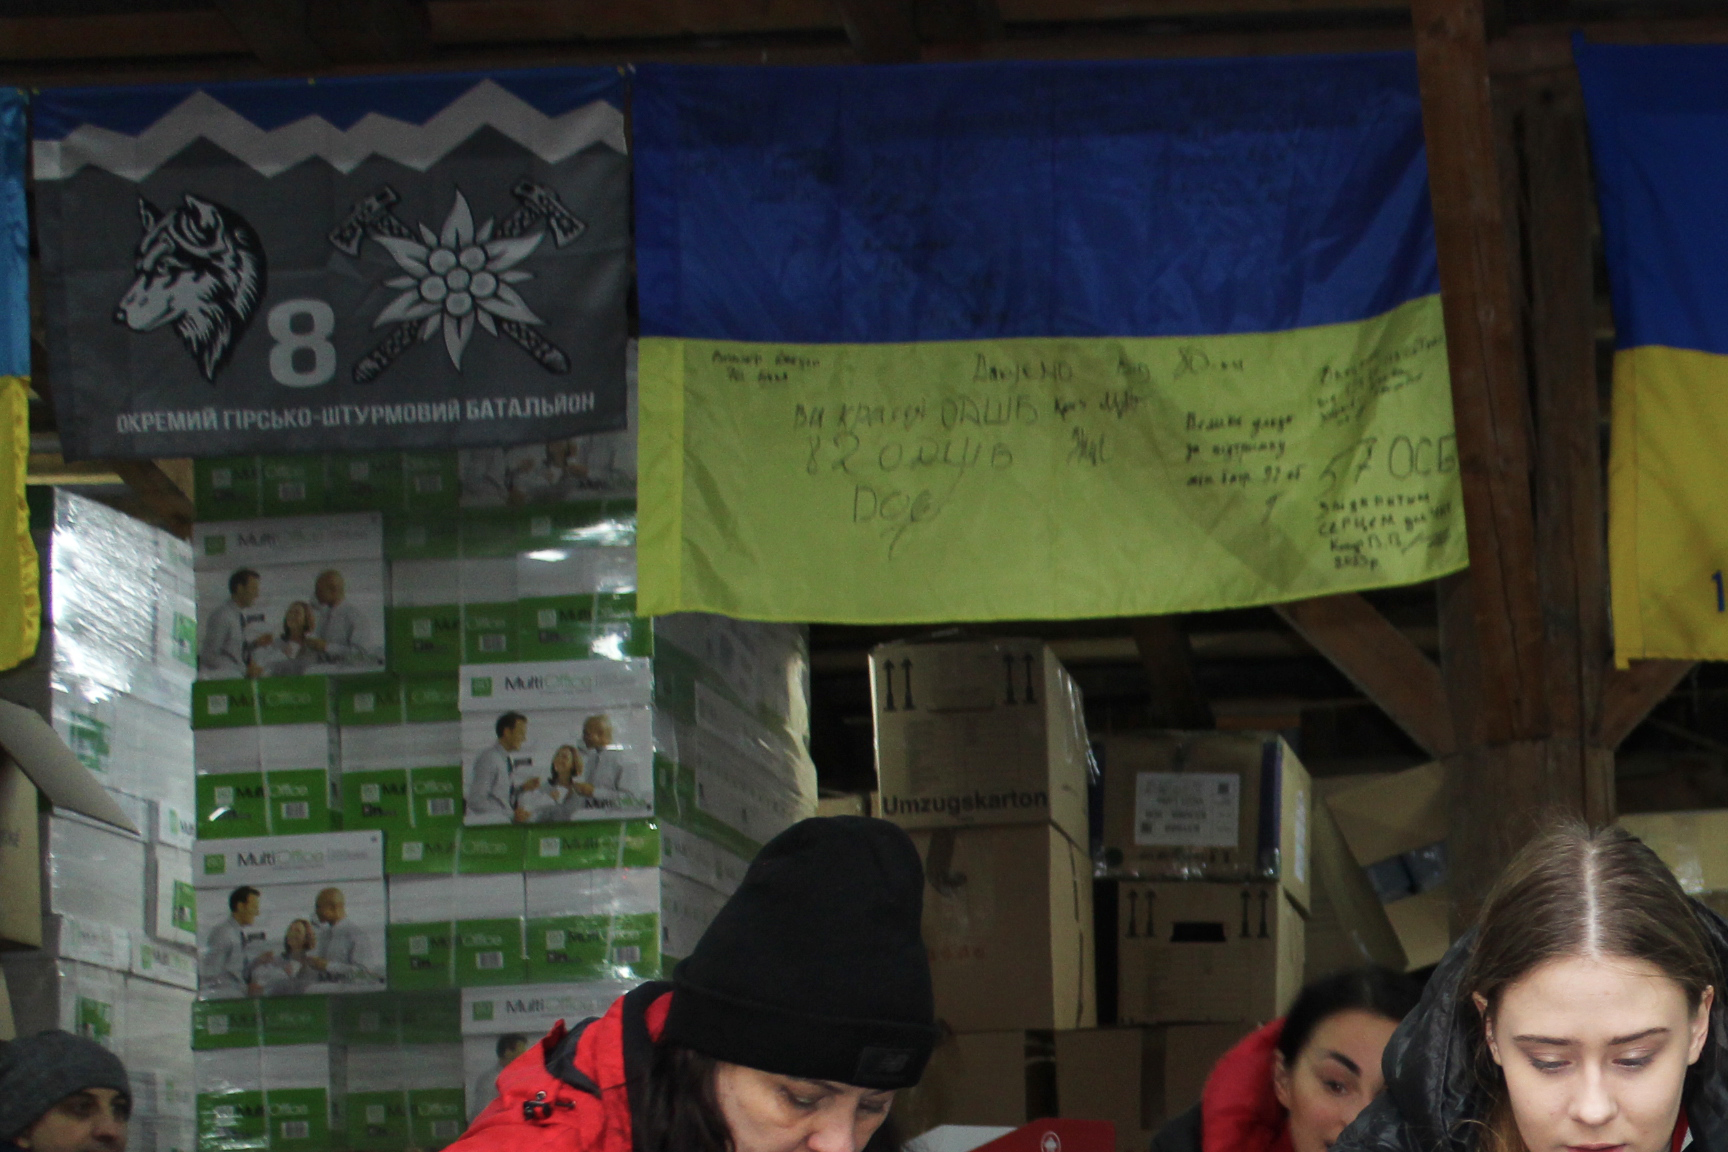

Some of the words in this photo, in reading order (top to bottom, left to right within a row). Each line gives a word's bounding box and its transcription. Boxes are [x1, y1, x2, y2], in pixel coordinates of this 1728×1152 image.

[267, 299, 337, 388] 8
[116, 408, 218, 434] ОКРЕМИЙ
[222, 397, 463, 432] ГІРСЬКО-ШТУРМОВИЙ
[466, 391, 595, 421] БАТАЛЬЙОН
[881, 788, 1048, 817] Umzugskarton
